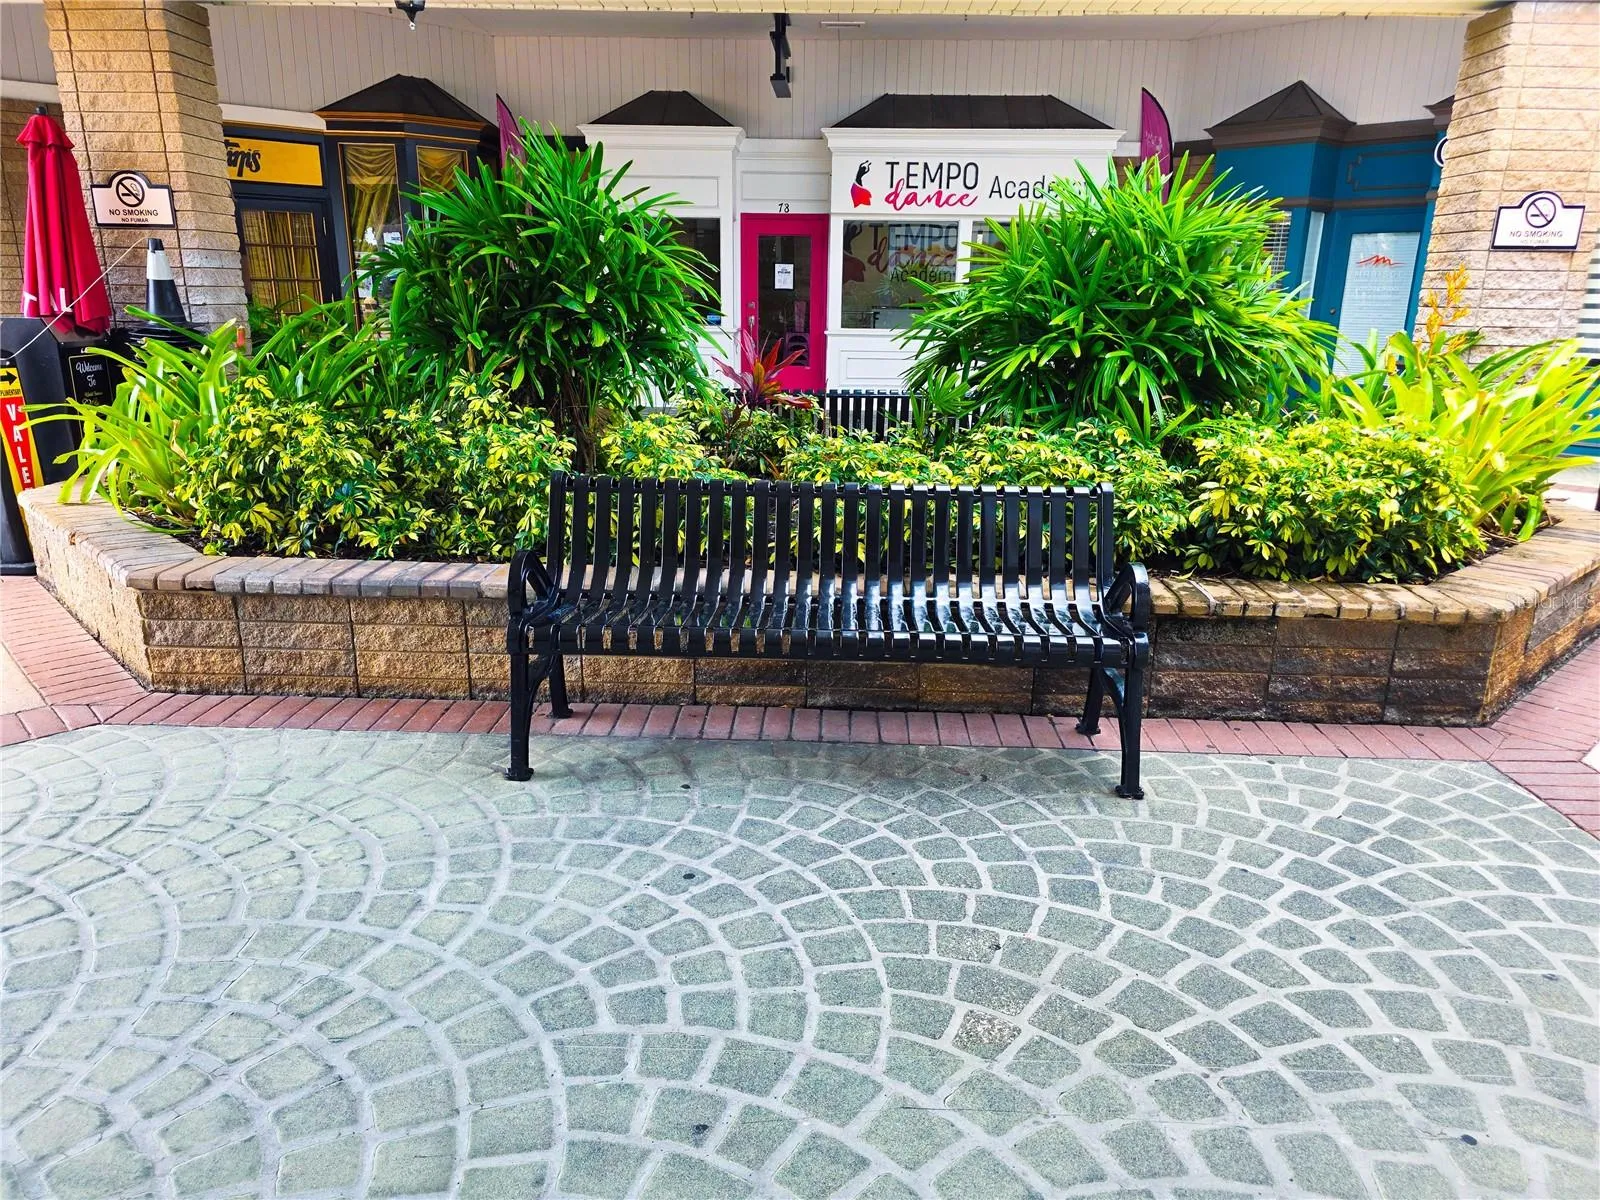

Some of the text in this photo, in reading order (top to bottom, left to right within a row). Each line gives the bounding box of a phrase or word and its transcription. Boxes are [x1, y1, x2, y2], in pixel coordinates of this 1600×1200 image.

[886, 161, 979, 190] TEMPO
[987, 175, 1087, 199] Acade
[884, 178, 978, 211] dance
[122, 209, 159, 217] SMOKING
[868, 223, 958, 250] TEMPO
[890, 266, 957, 282] Academ
[6, 403, 33, 490] VALE
